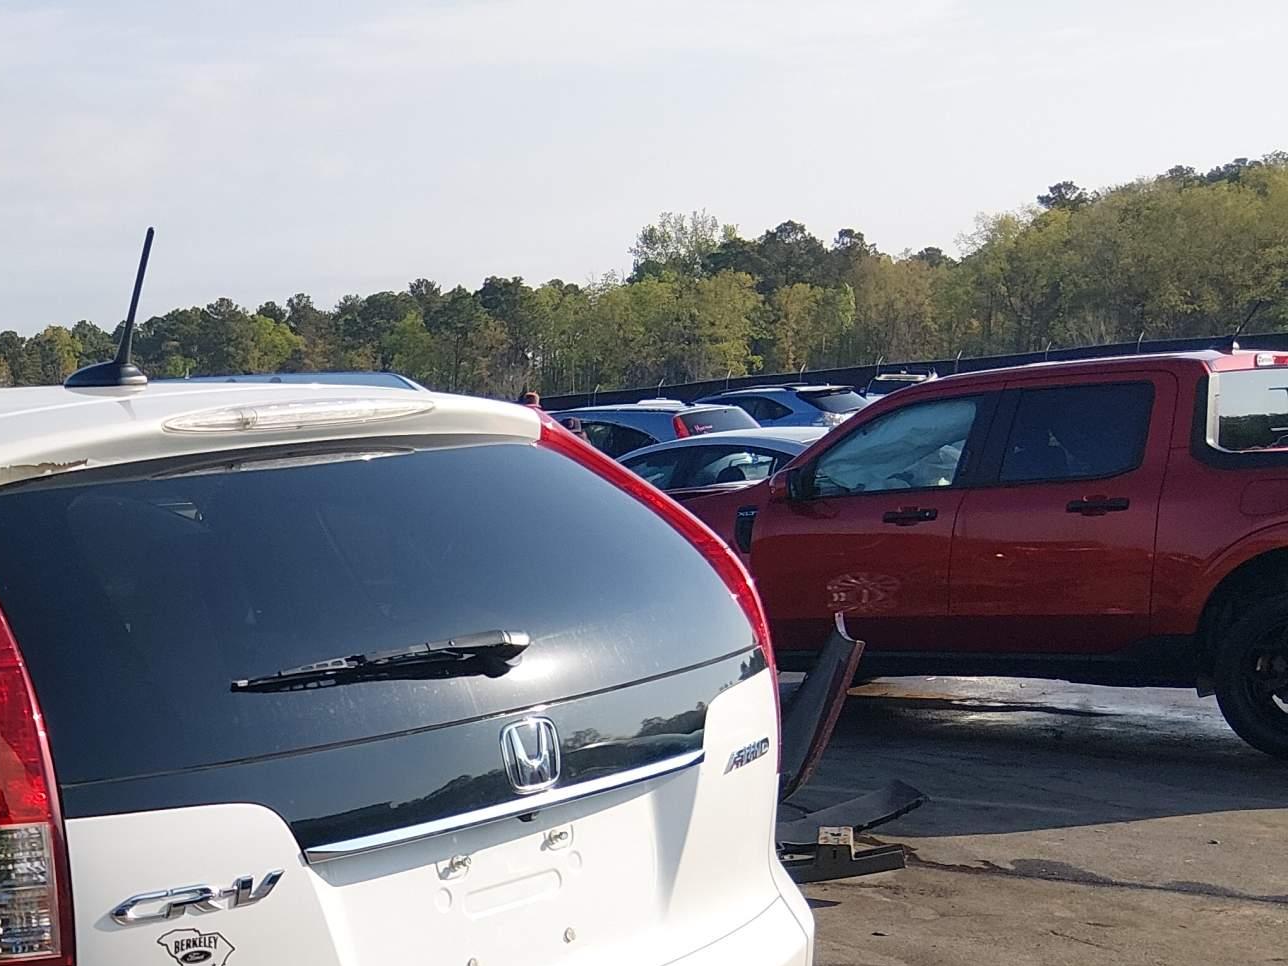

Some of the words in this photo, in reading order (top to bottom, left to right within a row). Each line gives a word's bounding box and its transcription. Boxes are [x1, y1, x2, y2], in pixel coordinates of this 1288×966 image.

[722, 736, 770, 775] AWD
[111, 867, 285, 926] CR-V
[174, 936, 218, 955] BERKELEY
